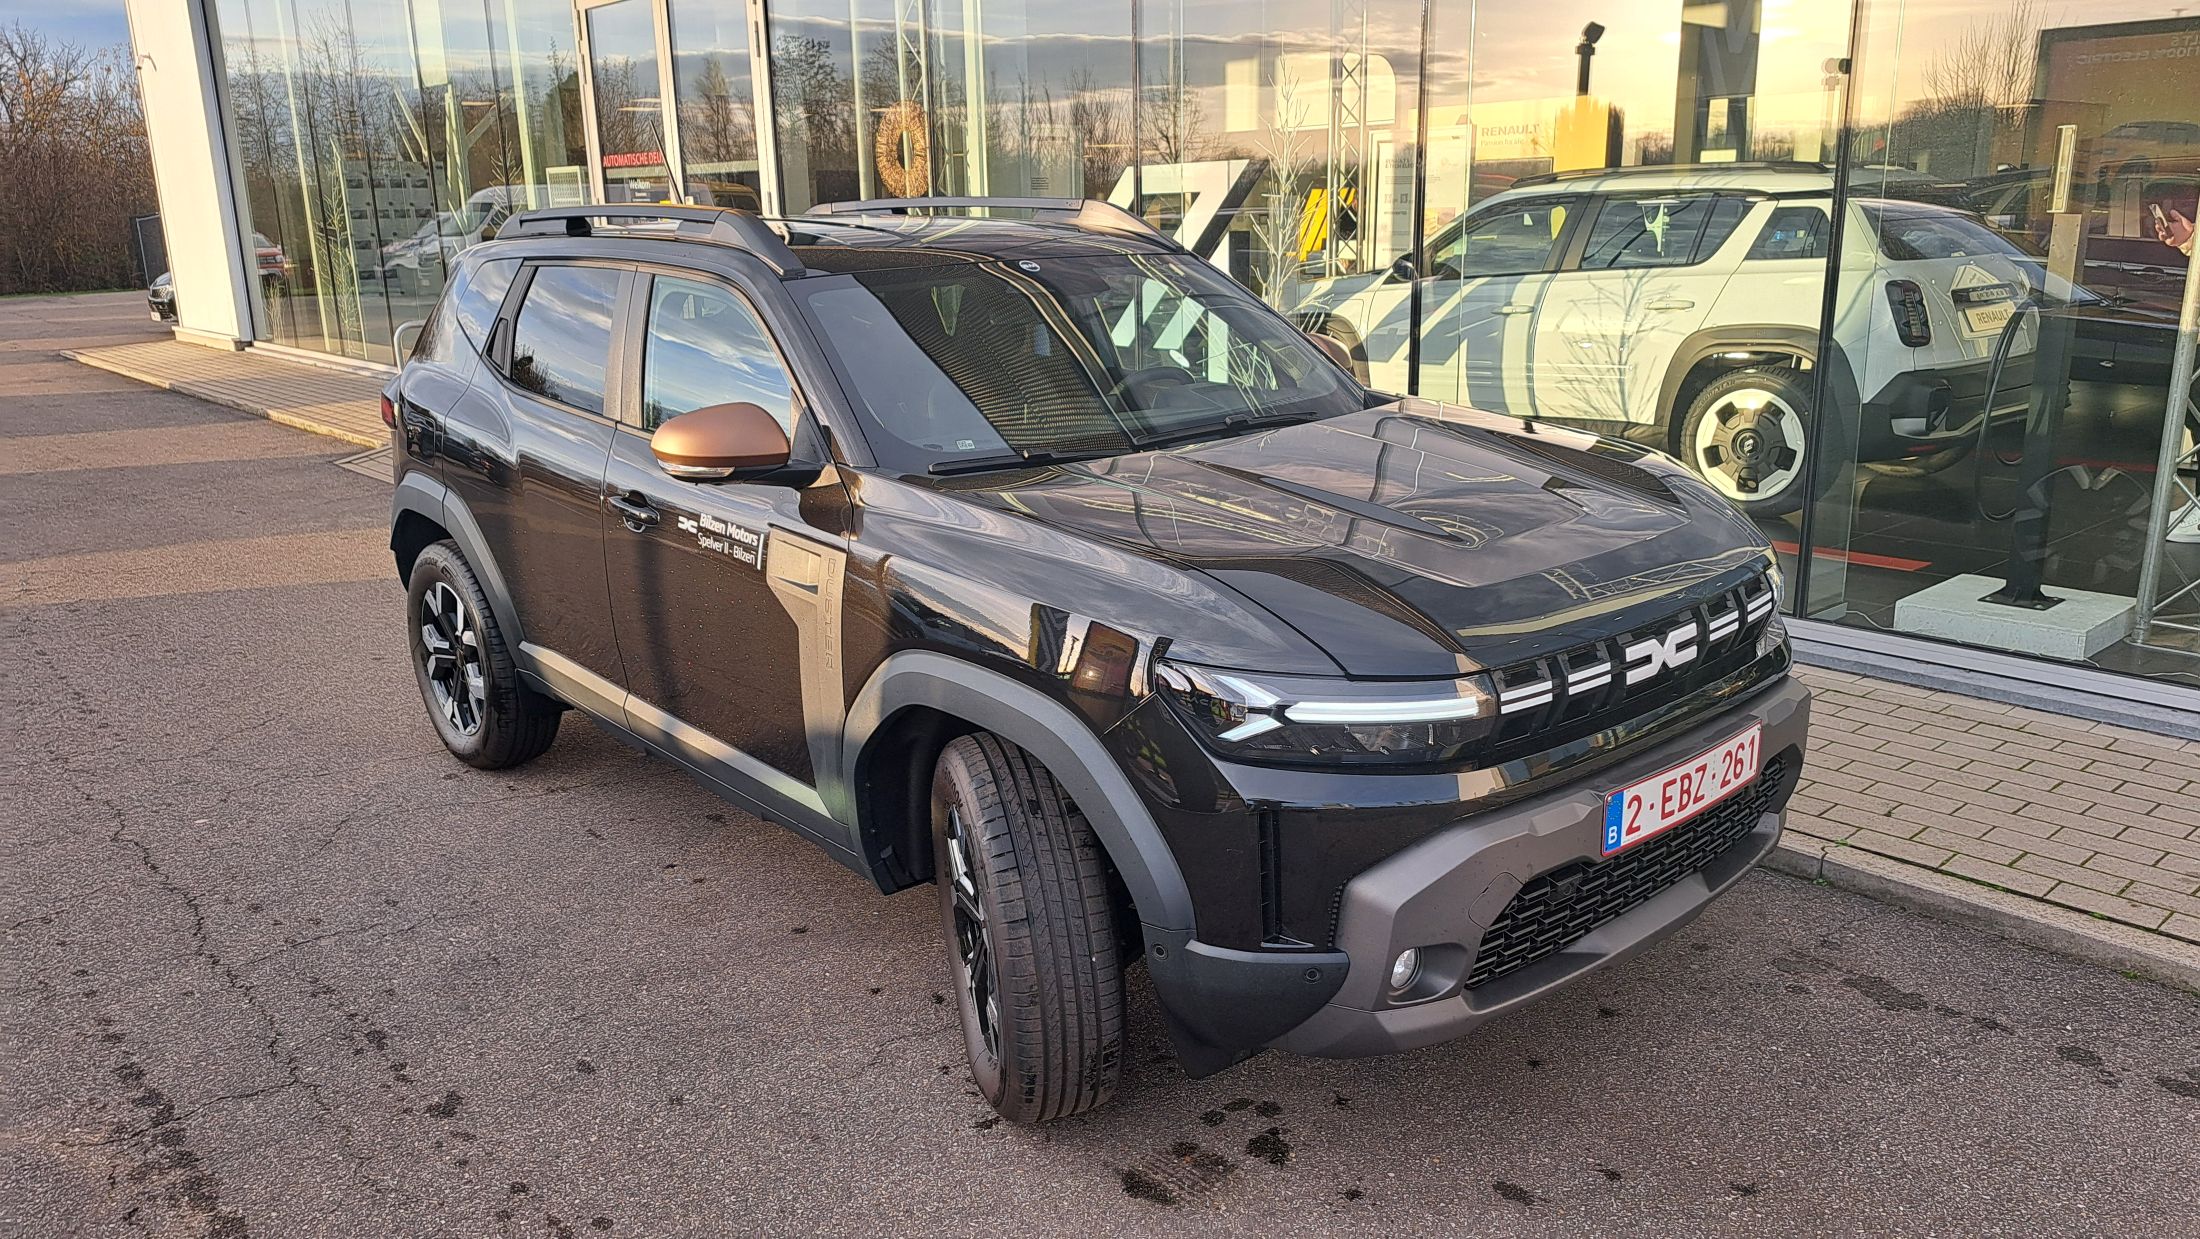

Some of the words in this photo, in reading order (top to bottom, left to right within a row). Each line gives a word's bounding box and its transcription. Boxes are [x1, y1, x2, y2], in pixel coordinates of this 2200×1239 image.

[1481, 123, 1540, 137] RENAULT
[603, 153, 648, 167] AUTOMATISCHE
[649, 151, 665, 164] DEU
[629, 179, 651, 190] Welkom
[1975, 308, 2010, 325] RENAULT
[700, 513, 725, 534] Bilzen
[727, 522, 758, 546] Motors
[697, 532, 723, 552] Spelver
[733, 545, 756, 565] Bilzen
[824, 557, 836, 670] DUSTER
[1608, 826, 1618, 845] B
